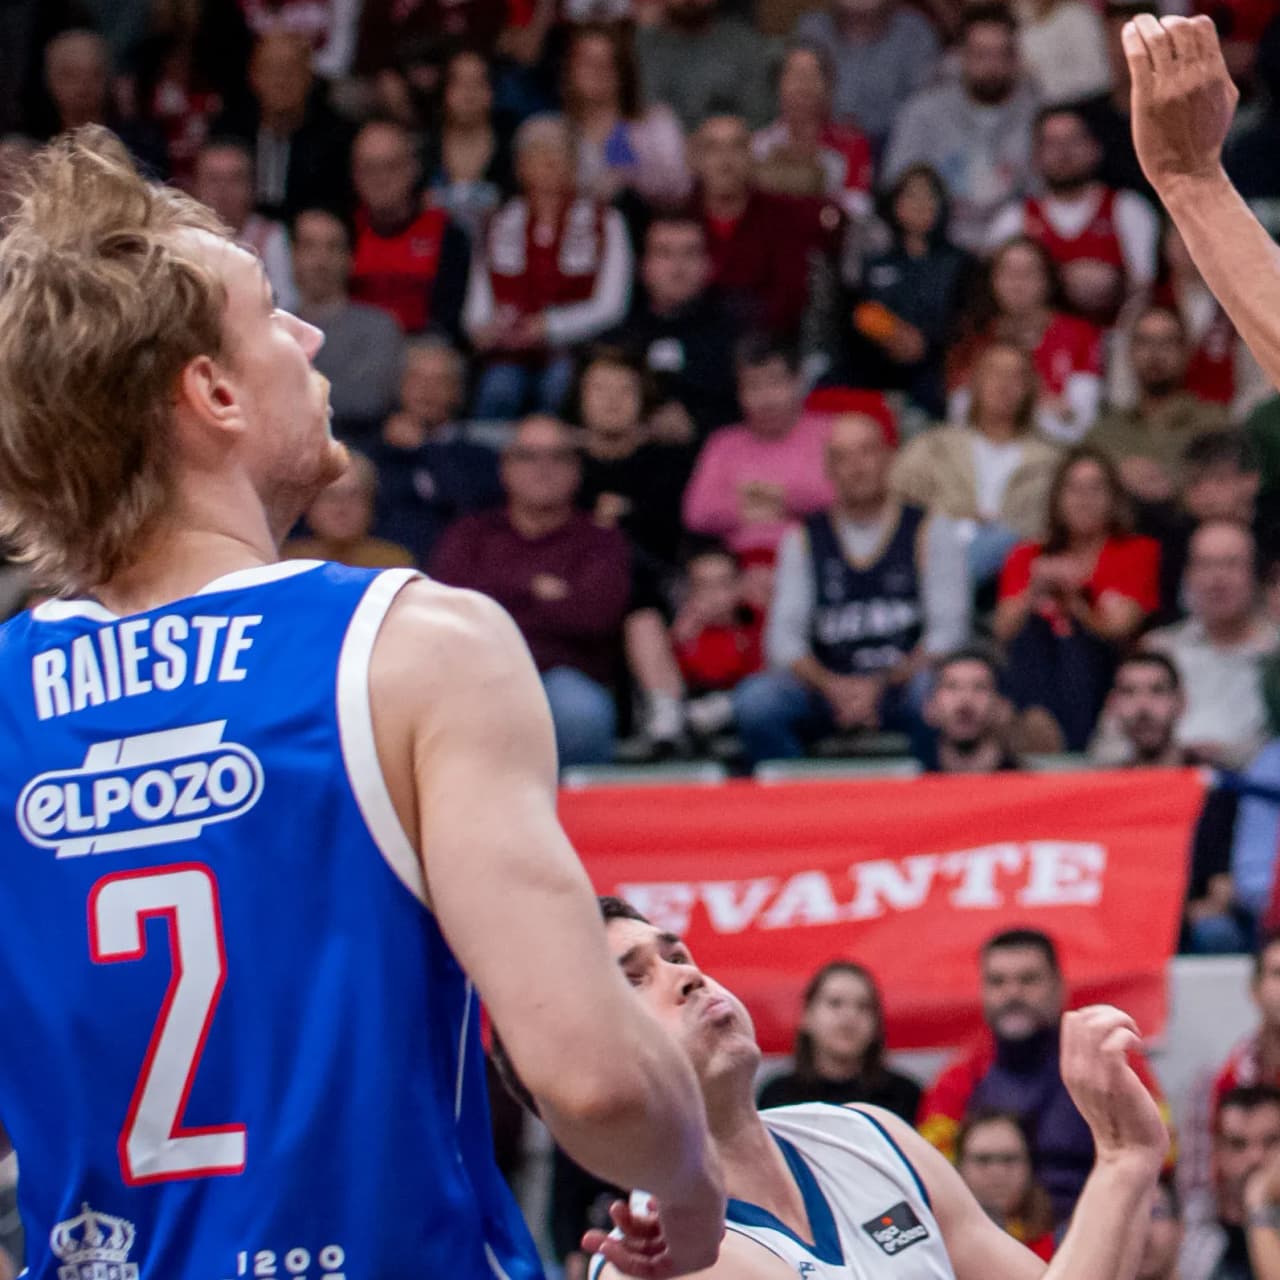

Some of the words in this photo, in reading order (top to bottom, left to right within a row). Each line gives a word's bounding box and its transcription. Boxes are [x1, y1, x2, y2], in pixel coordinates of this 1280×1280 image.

[32, 614, 263, 720] RAIESTE
[87, 861, 247, 1186] 2
[237, 1244, 345, 1277] 1200
